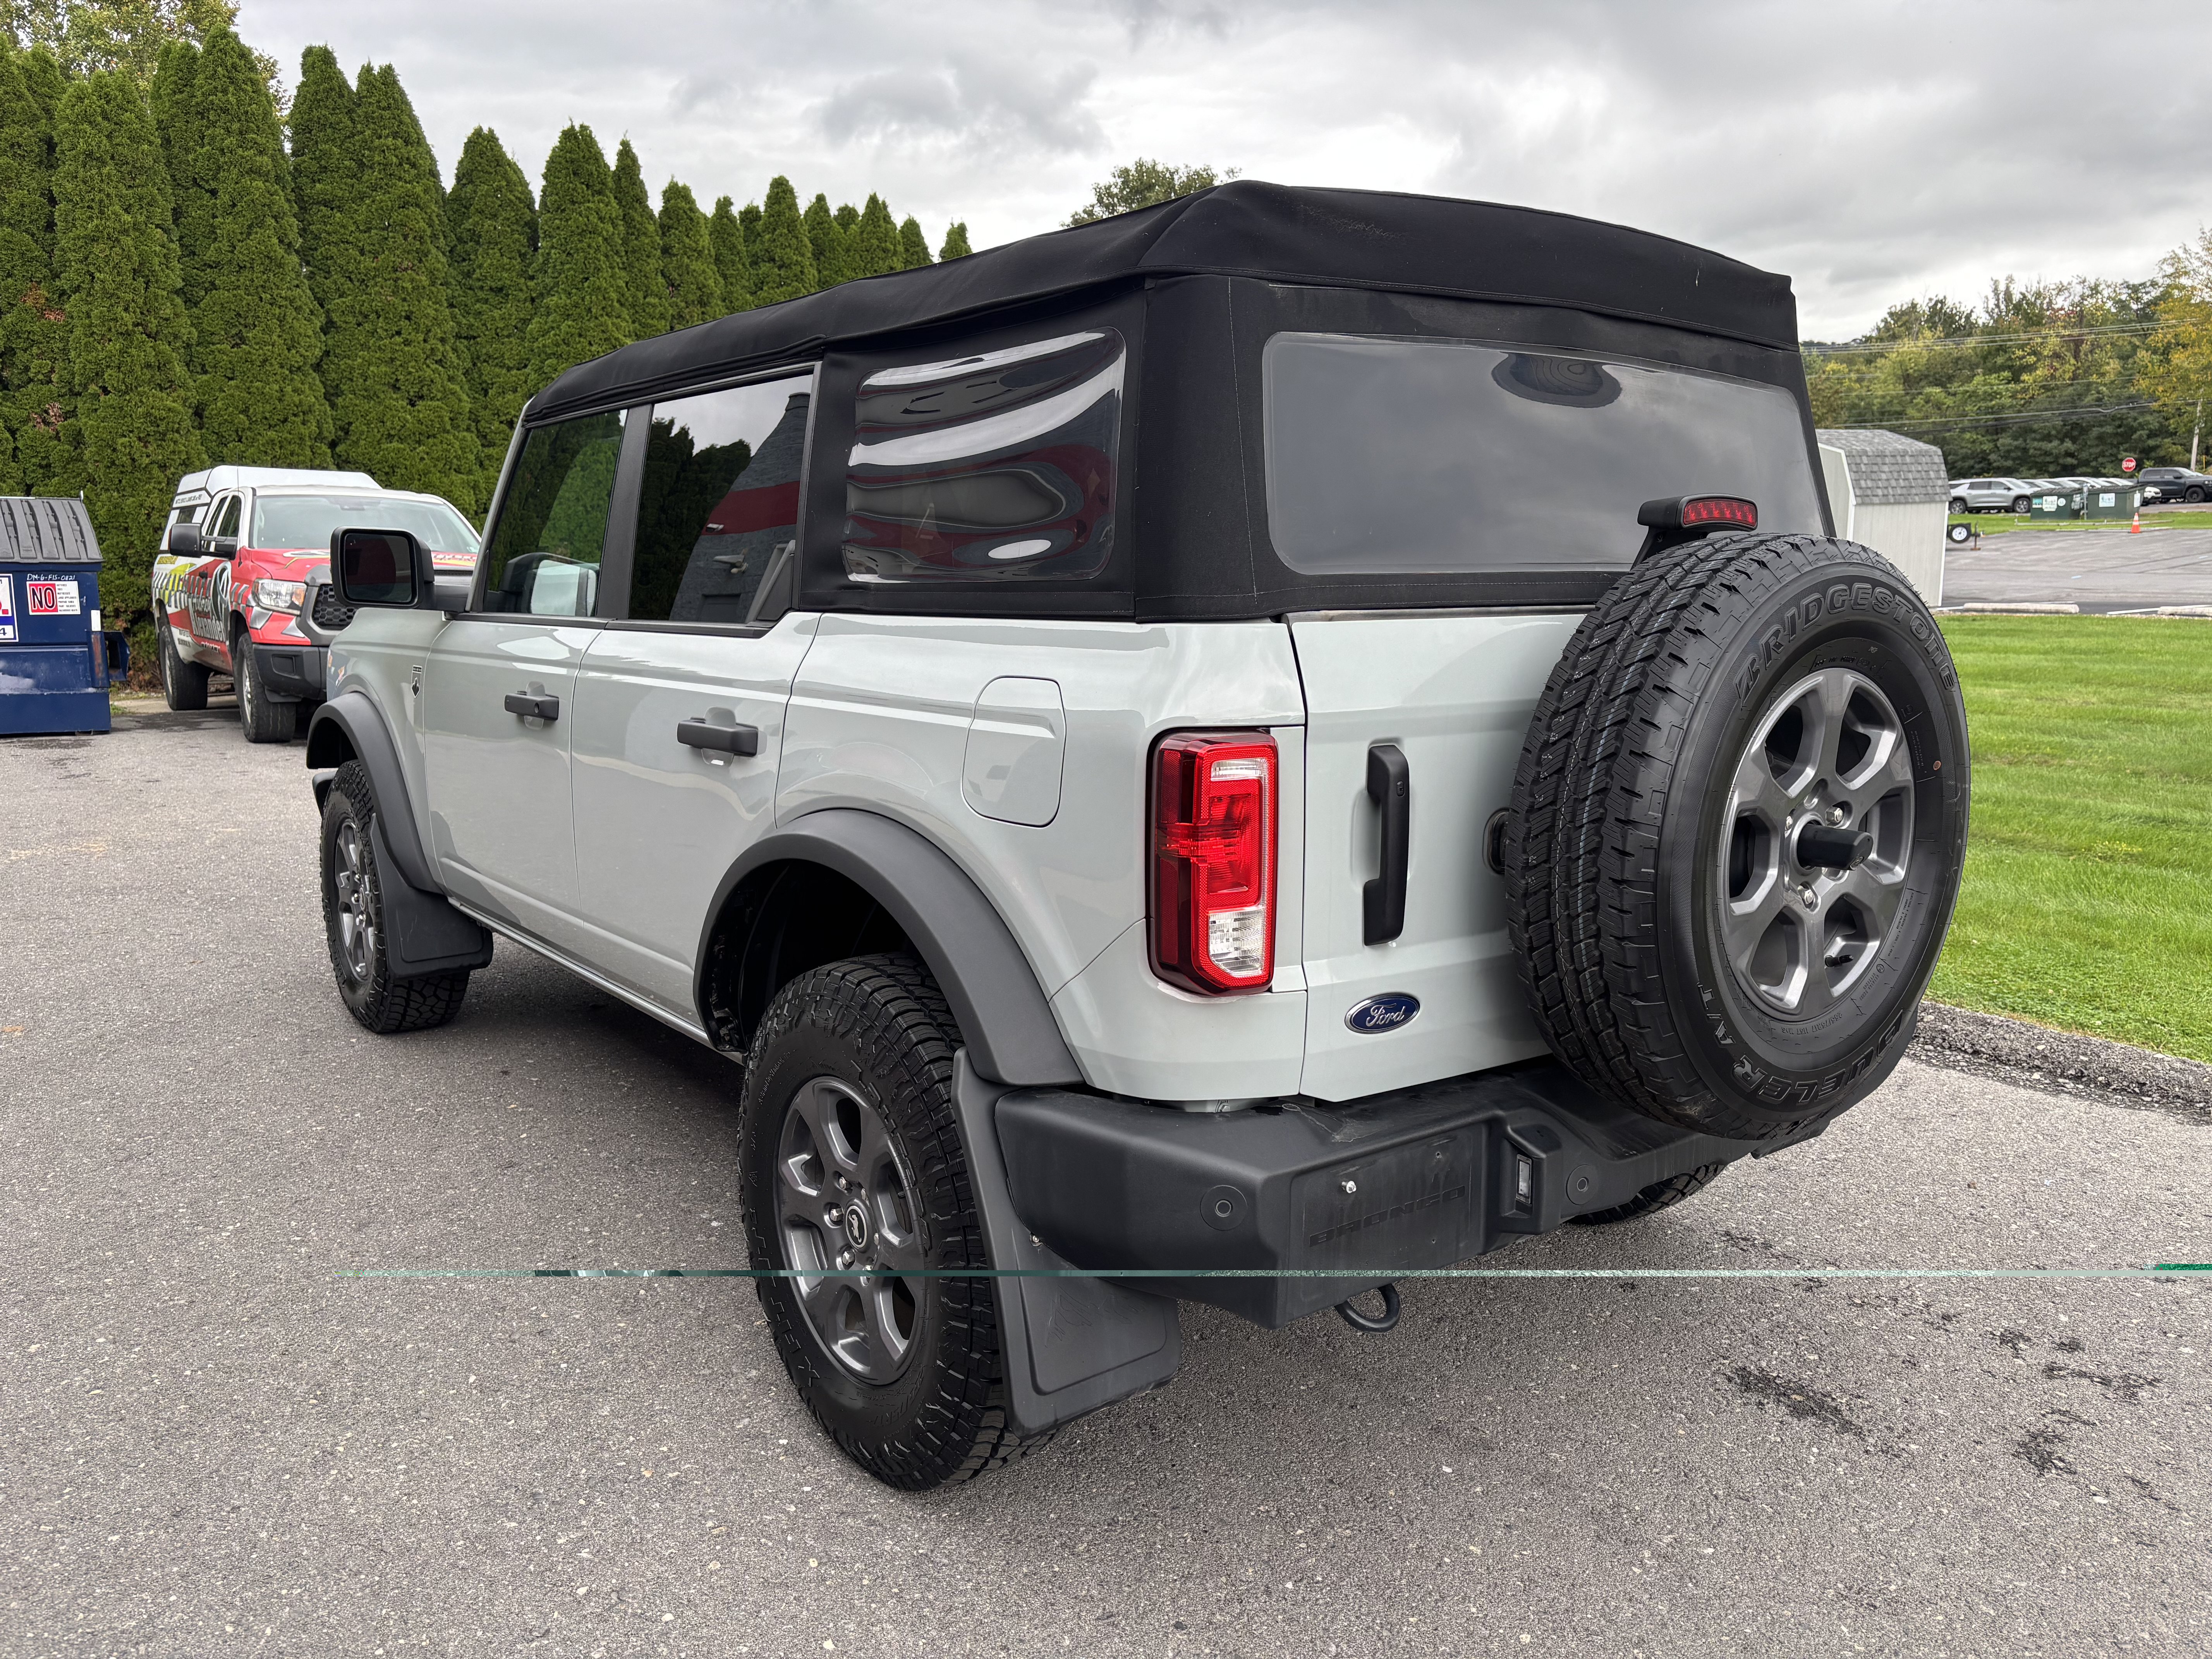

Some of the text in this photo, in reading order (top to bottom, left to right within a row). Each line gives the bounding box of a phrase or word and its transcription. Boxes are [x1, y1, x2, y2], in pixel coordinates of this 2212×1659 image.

[31, 586, 56, 610] NO
[1735, 582, 1955, 700] BRIDGESTONE
[1366, 1003, 1406, 1027] Ford
[1733, 1008, 1903, 1106] DUELER
[1309, 1185, 1465, 1247] BRONCO
